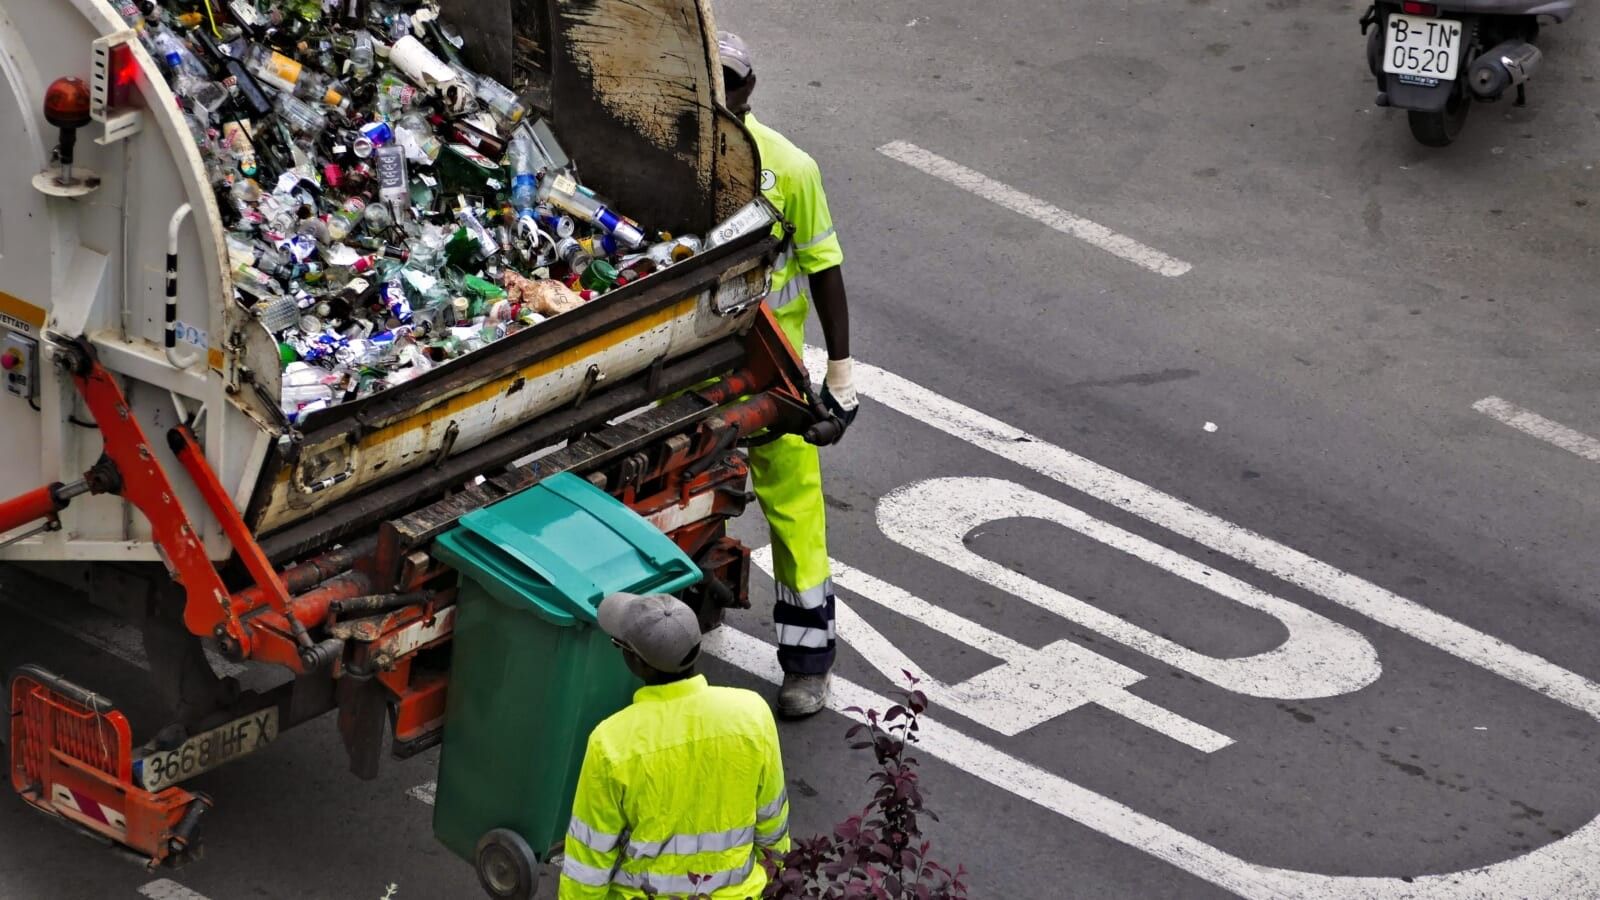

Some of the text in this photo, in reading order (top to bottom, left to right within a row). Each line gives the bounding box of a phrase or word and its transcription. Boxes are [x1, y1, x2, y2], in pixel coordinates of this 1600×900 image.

[1395, 19, 1452, 48] B-TN
[1392, 46, 1449, 73] 0520
[751, 476, 1382, 754] 40
[150, 739, 210, 786] 3668
